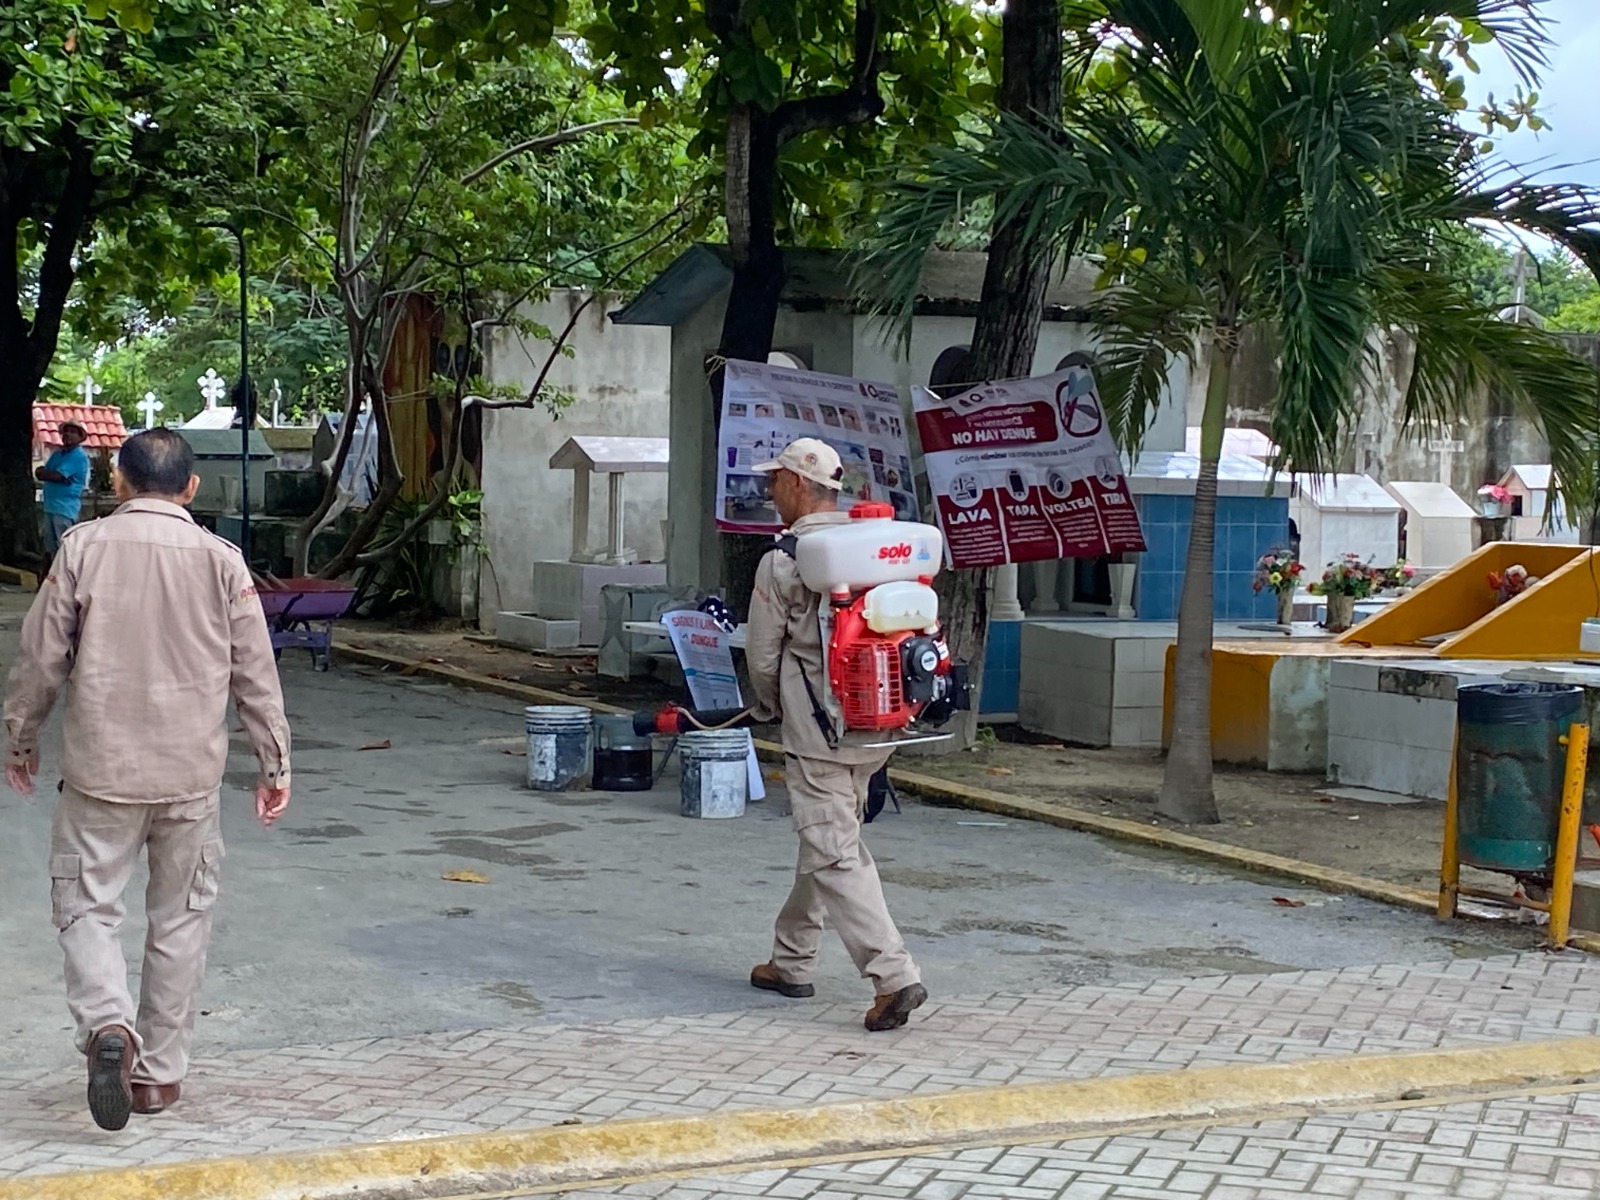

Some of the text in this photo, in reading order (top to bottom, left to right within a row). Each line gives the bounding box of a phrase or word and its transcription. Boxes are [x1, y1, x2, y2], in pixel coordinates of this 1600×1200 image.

[952, 432, 972, 445] NO
[975, 429, 1000, 442] HAY
[1006, 504, 1039, 517] TAPA
[1045, 496, 1095, 514] VOLTEA
[948, 507, 992, 525] LAVA
[878, 542, 912, 559] solo
